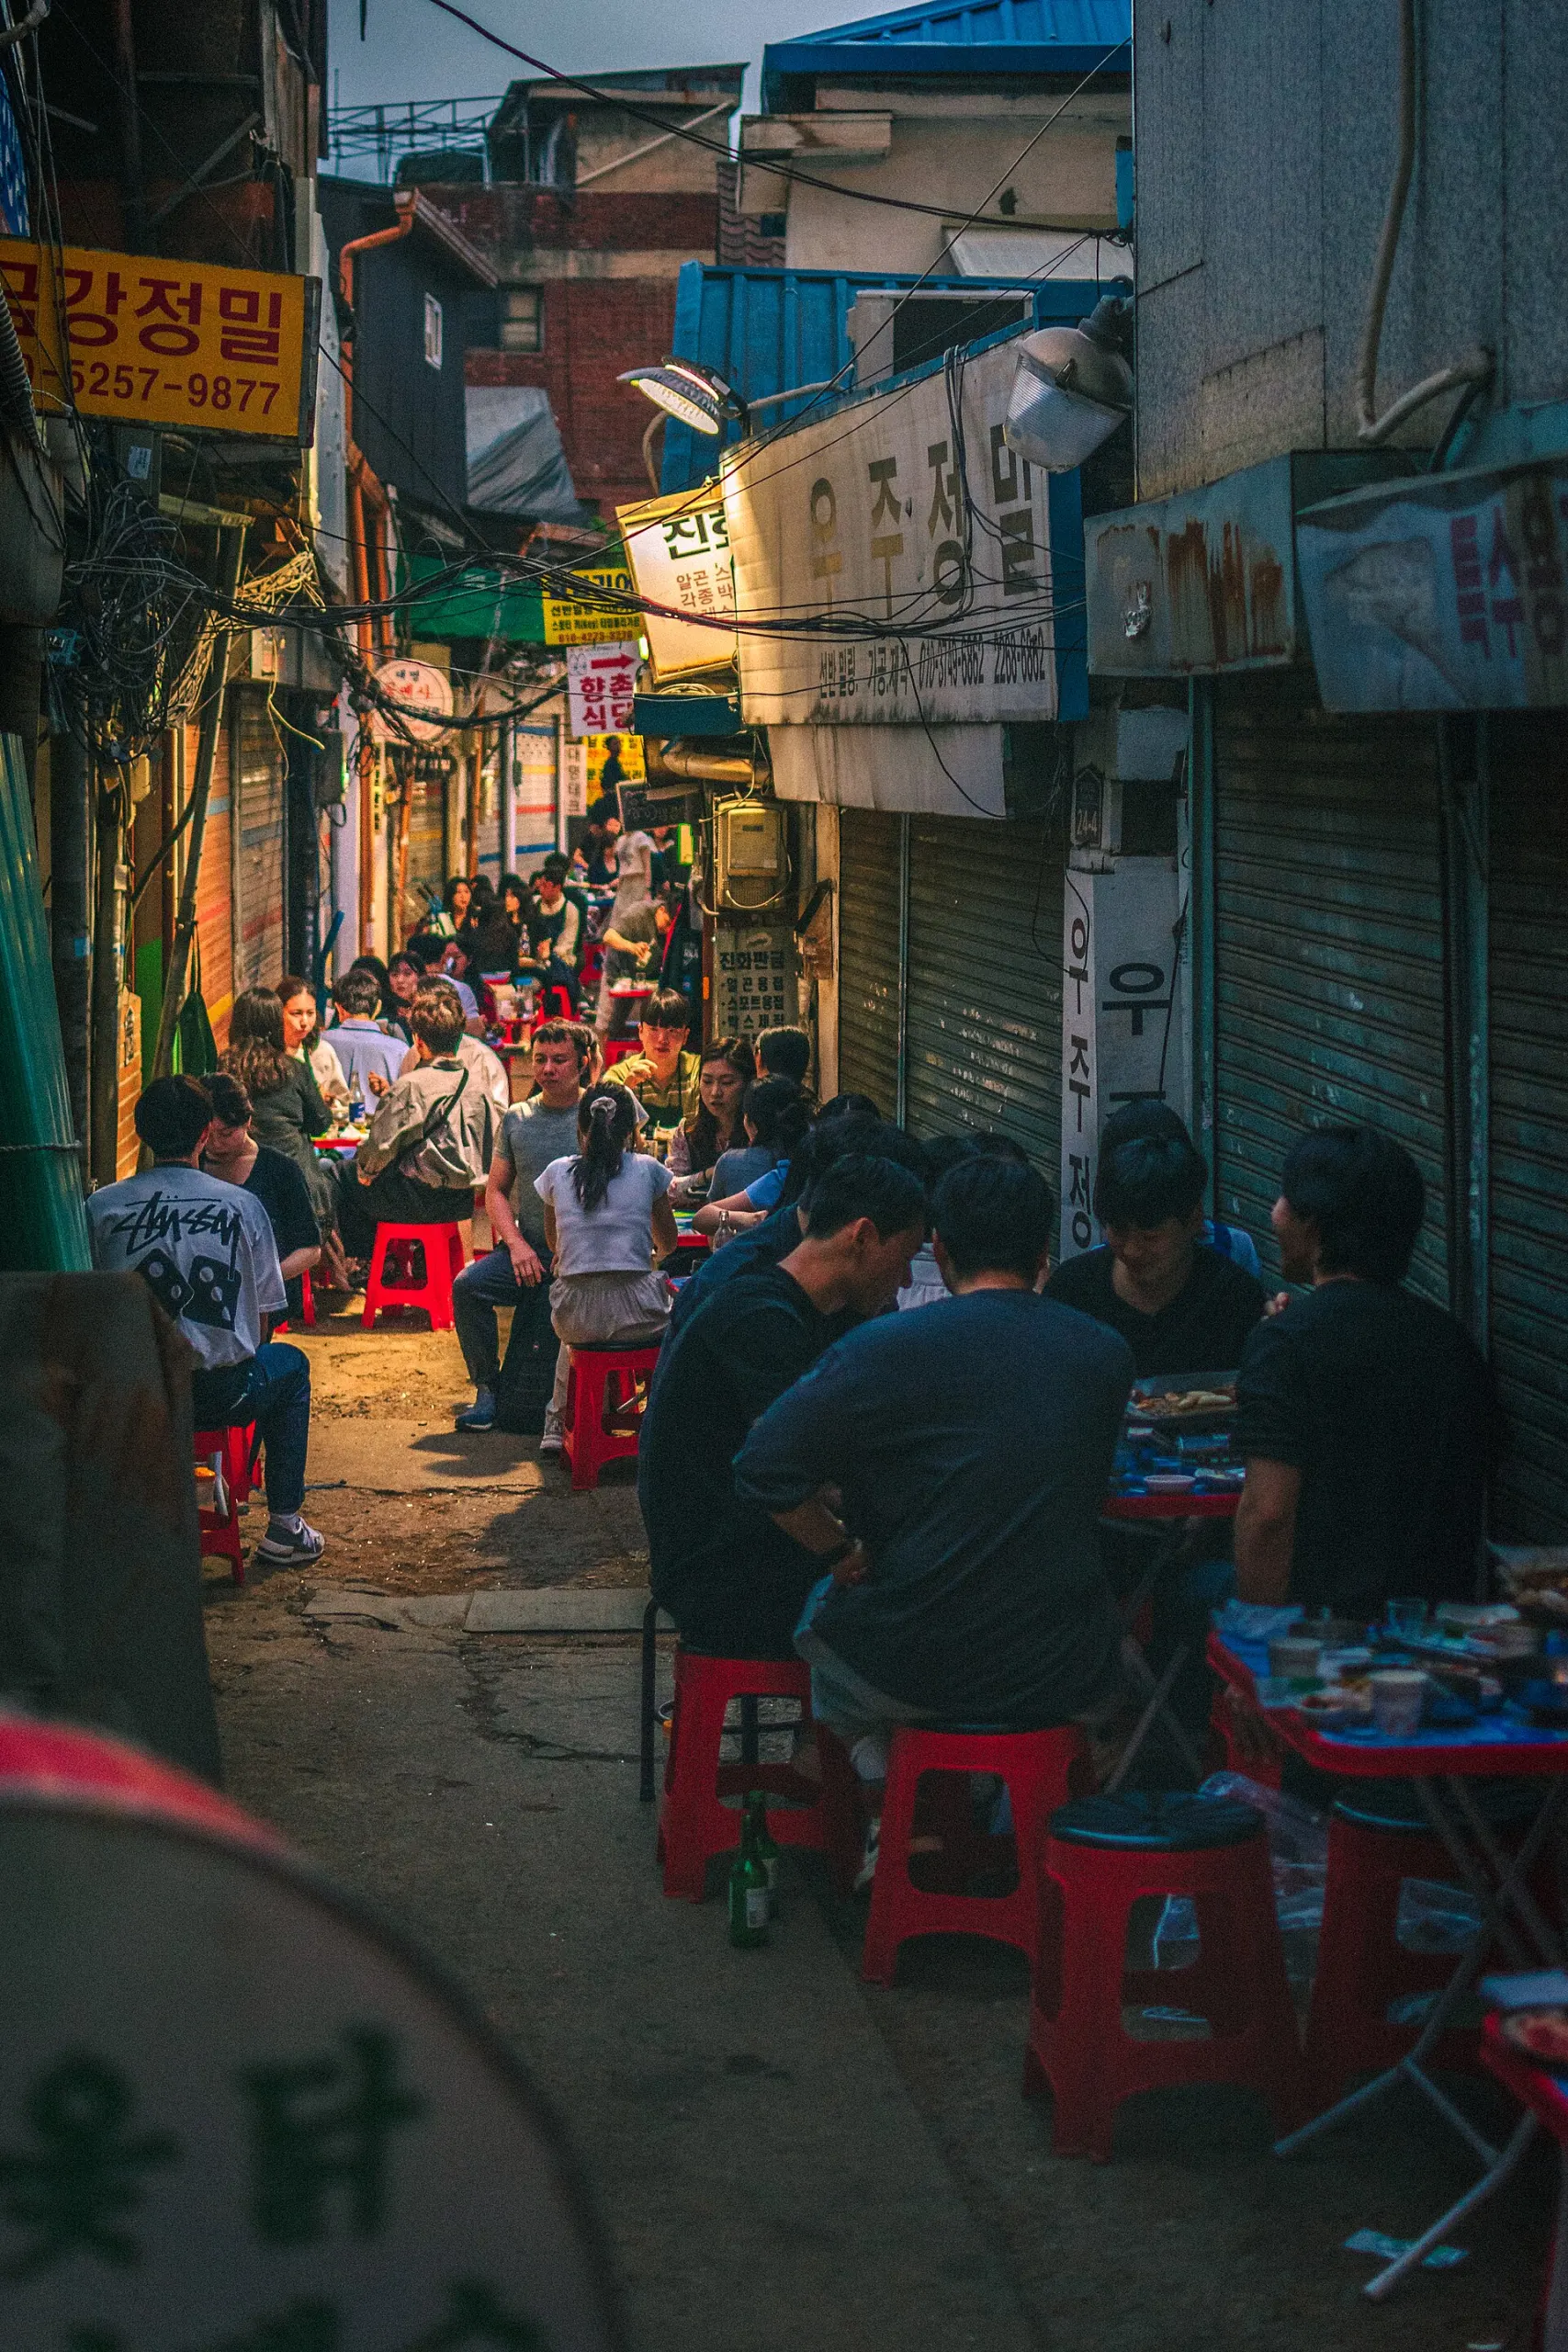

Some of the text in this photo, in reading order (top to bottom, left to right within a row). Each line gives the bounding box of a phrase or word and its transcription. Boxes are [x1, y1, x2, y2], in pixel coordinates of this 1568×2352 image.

[810, 424, 1038, 620] 우주정밀
[681, 586, 714, 608] 각종
[580, 673, 633, 703] 향촌
